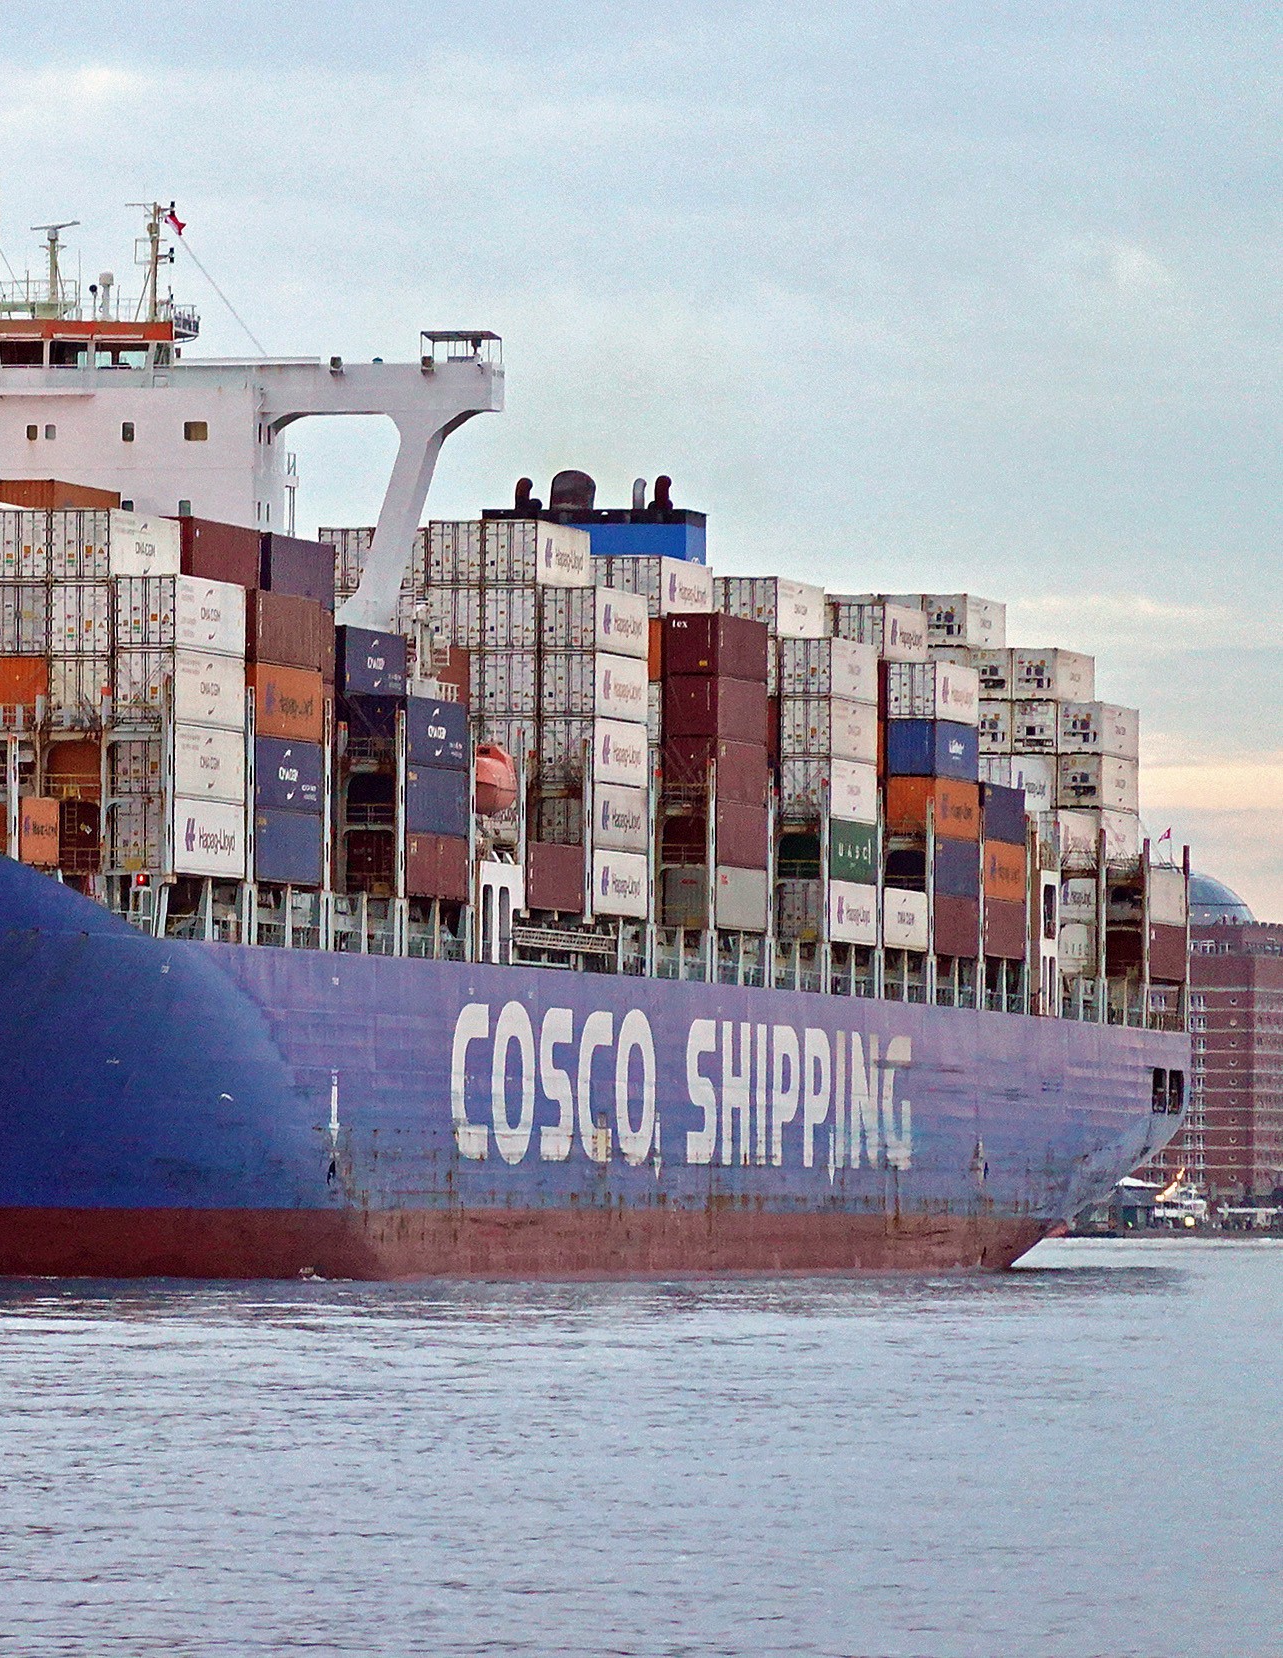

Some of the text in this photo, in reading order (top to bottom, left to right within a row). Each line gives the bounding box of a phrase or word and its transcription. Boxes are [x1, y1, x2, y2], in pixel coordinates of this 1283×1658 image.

[671, 619, 688, 629] tex
[199, 826, 236, 857] Hapag-Lloyd
[451, 1000, 912, 1171] COSCO SHIPPING
